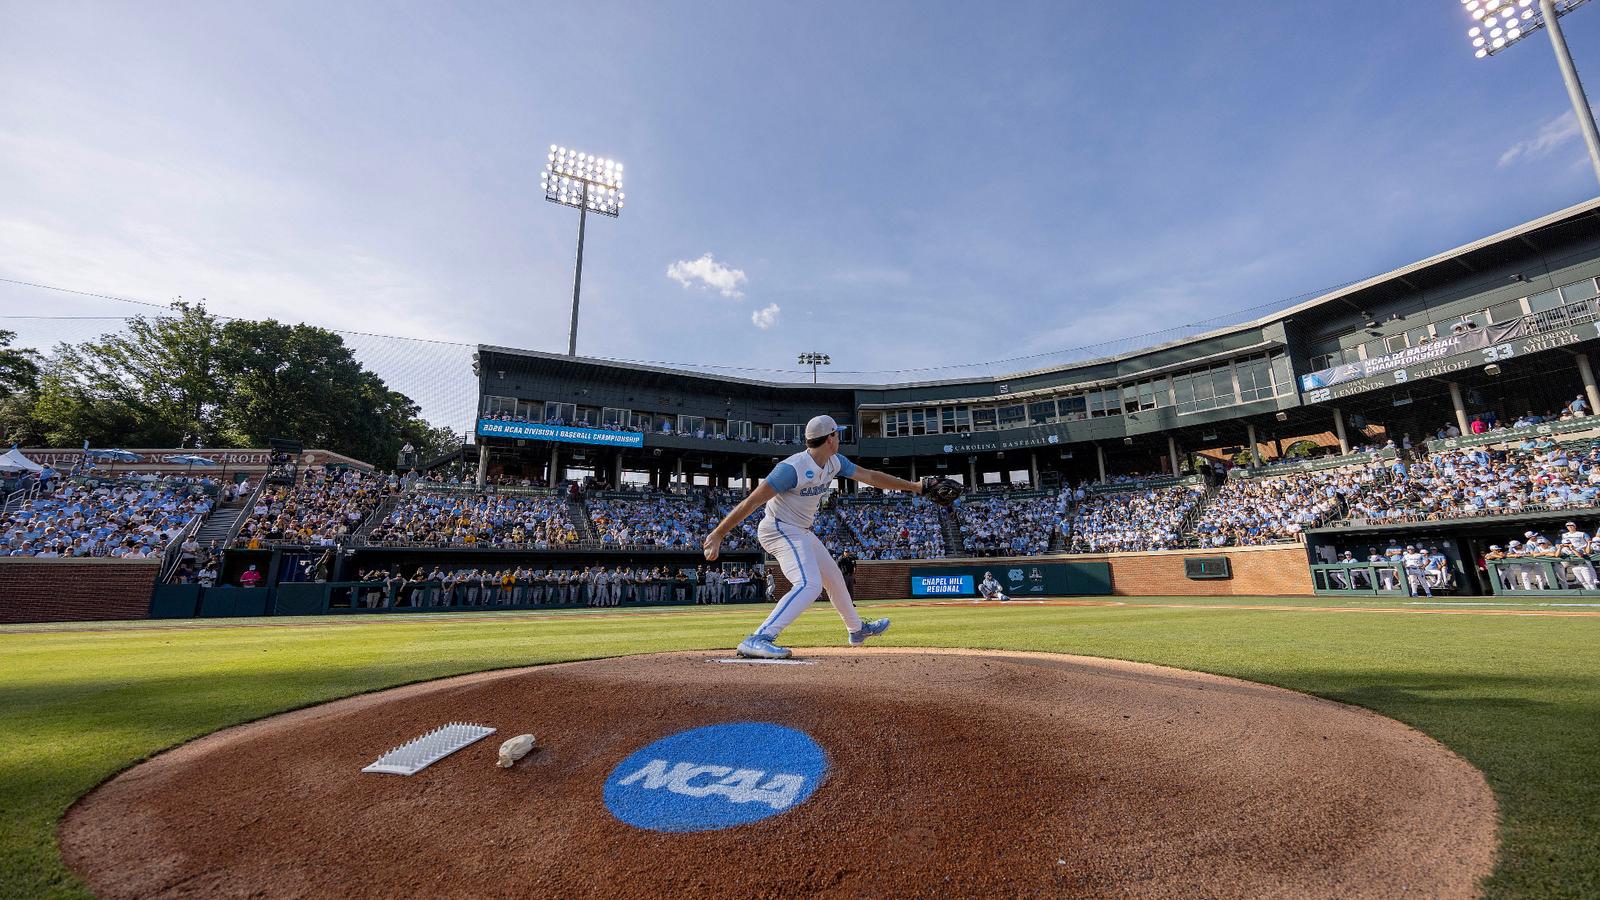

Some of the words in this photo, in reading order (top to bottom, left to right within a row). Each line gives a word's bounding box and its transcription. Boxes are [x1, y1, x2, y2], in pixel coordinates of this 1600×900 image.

[1523, 333, 1580, 354] MILLER
[1527, 329, 1572, 345] ANDREW
[1364, 355, 1390, 368] NCAA
[1406, 336, 1460, 356] BASEBALL
[1366, 348, 1448, 374] CHAMPIONSHIP
[1482, 343, 1515, 363] 33
[1393, 369, 1408, 384] 9
[1414, 359, 1471, 379] SURHOFF
[1310, 388, 1332, 404] 22
[1334, 381, 1385, 399] LEMONDS
[504, 425, 522, 434] NCAA
[524, 427, 554, 437] DIVISION
[560, 430, 591, 440] BASEBALL
[593, 433, 640, 443] CHAMPIONSHIP
[954, 443, 996, 452] CAROLINA
[1002, 437, 1046, 448] BASEBALL
[209, 454, 272, 464] CAROLIN
[922, 577, 947, 586] CHAPEL
[949, 577, 963, 585] HILL
[926, 585, 960, 593] REGIONAL
[617, 758, 806, 810] NCAA
